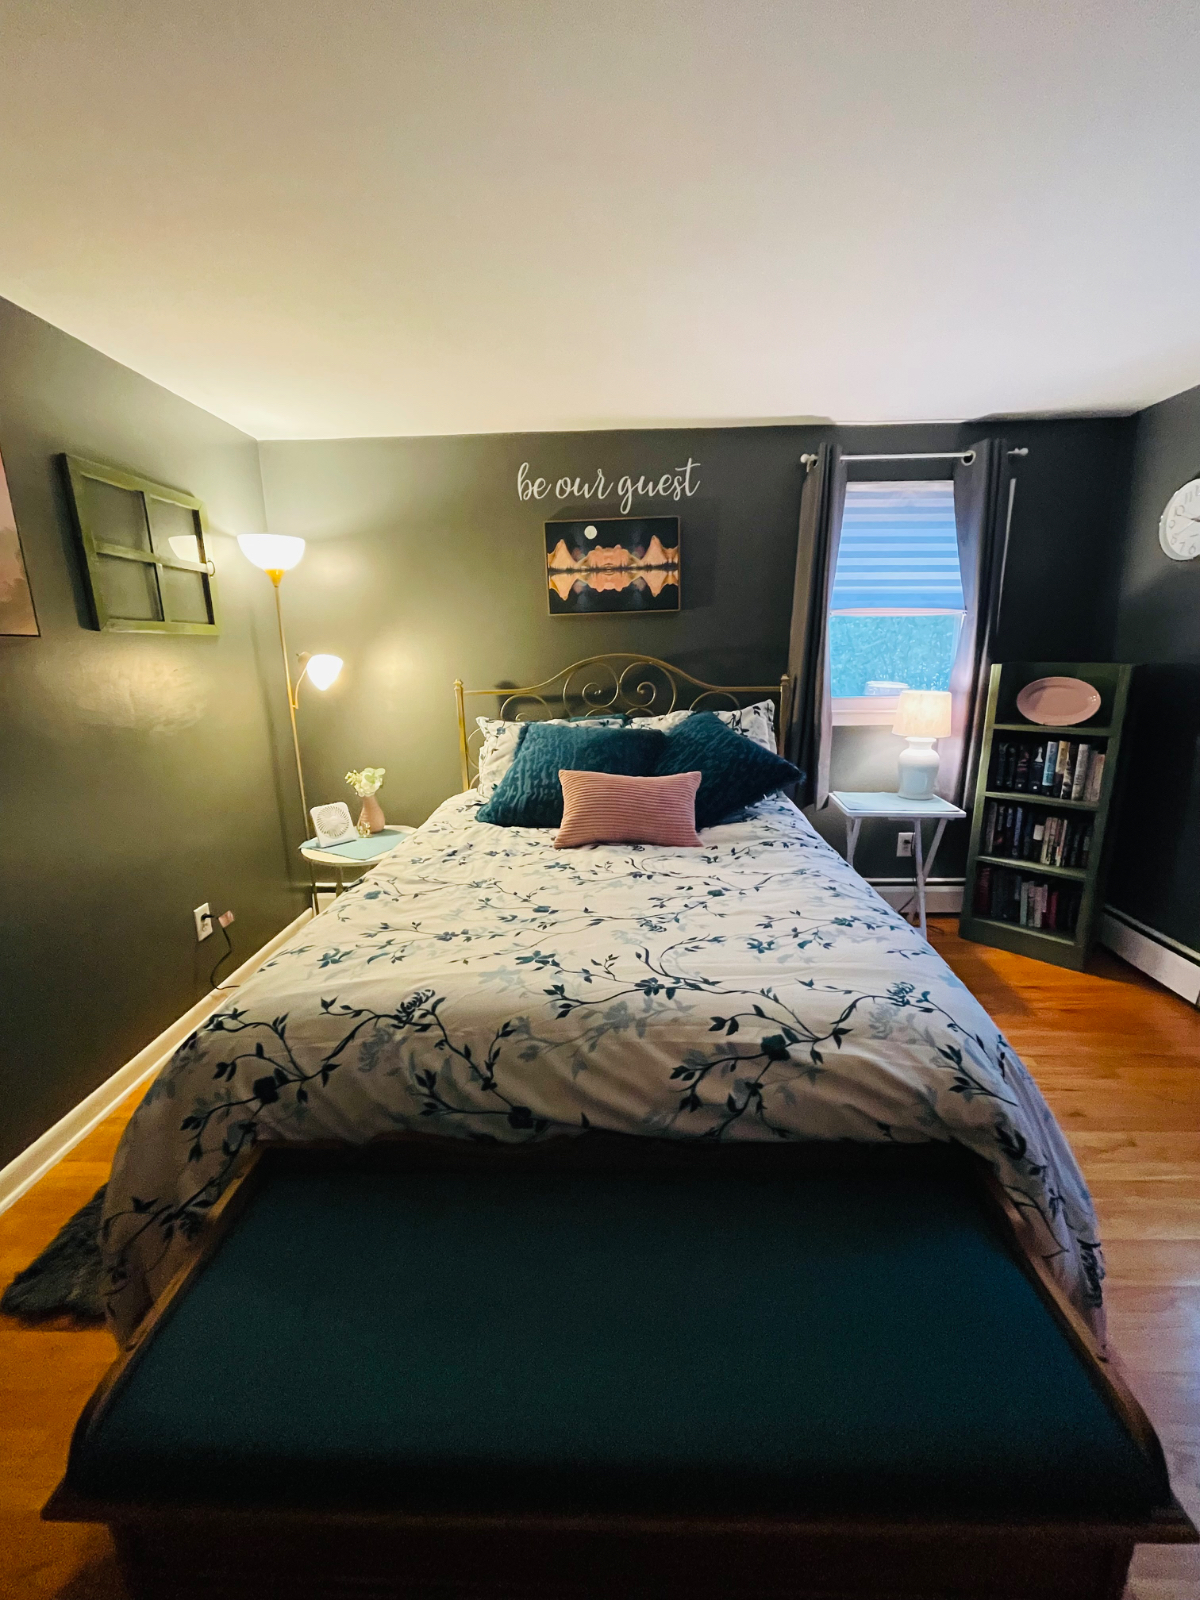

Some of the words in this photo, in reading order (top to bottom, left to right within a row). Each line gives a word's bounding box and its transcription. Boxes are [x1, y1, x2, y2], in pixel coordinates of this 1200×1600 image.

[517, 462, 551, 501] be
[555, 468, 614, 500] our
[617, 457, 701, 515] guest
